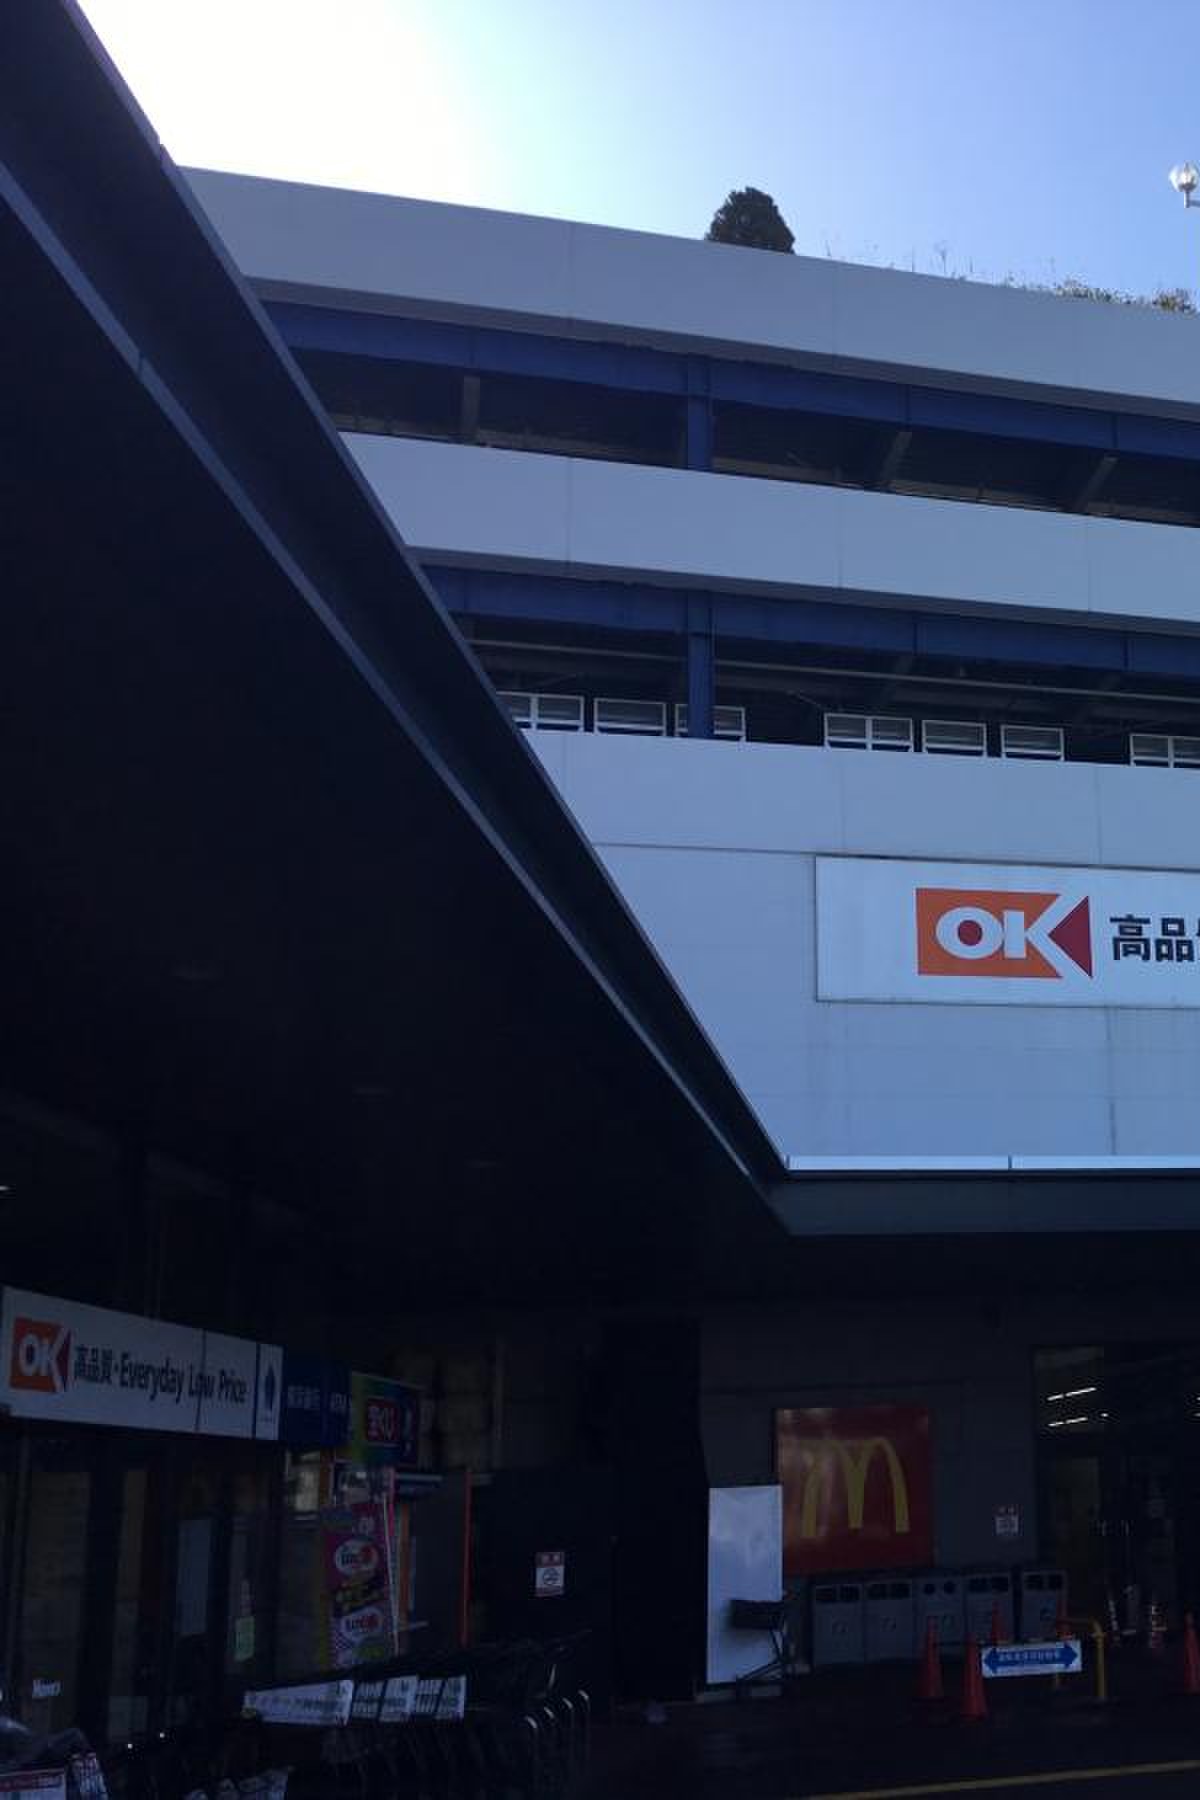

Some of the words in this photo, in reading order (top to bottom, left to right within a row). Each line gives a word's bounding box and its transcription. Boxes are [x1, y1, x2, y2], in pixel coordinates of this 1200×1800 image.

[934, 890, 1092, 978] OK
[18, 1330, 72, 1392] OK
[188, 1364, 214, 1398] Low
[217, 1370, 247, 1403] Price
